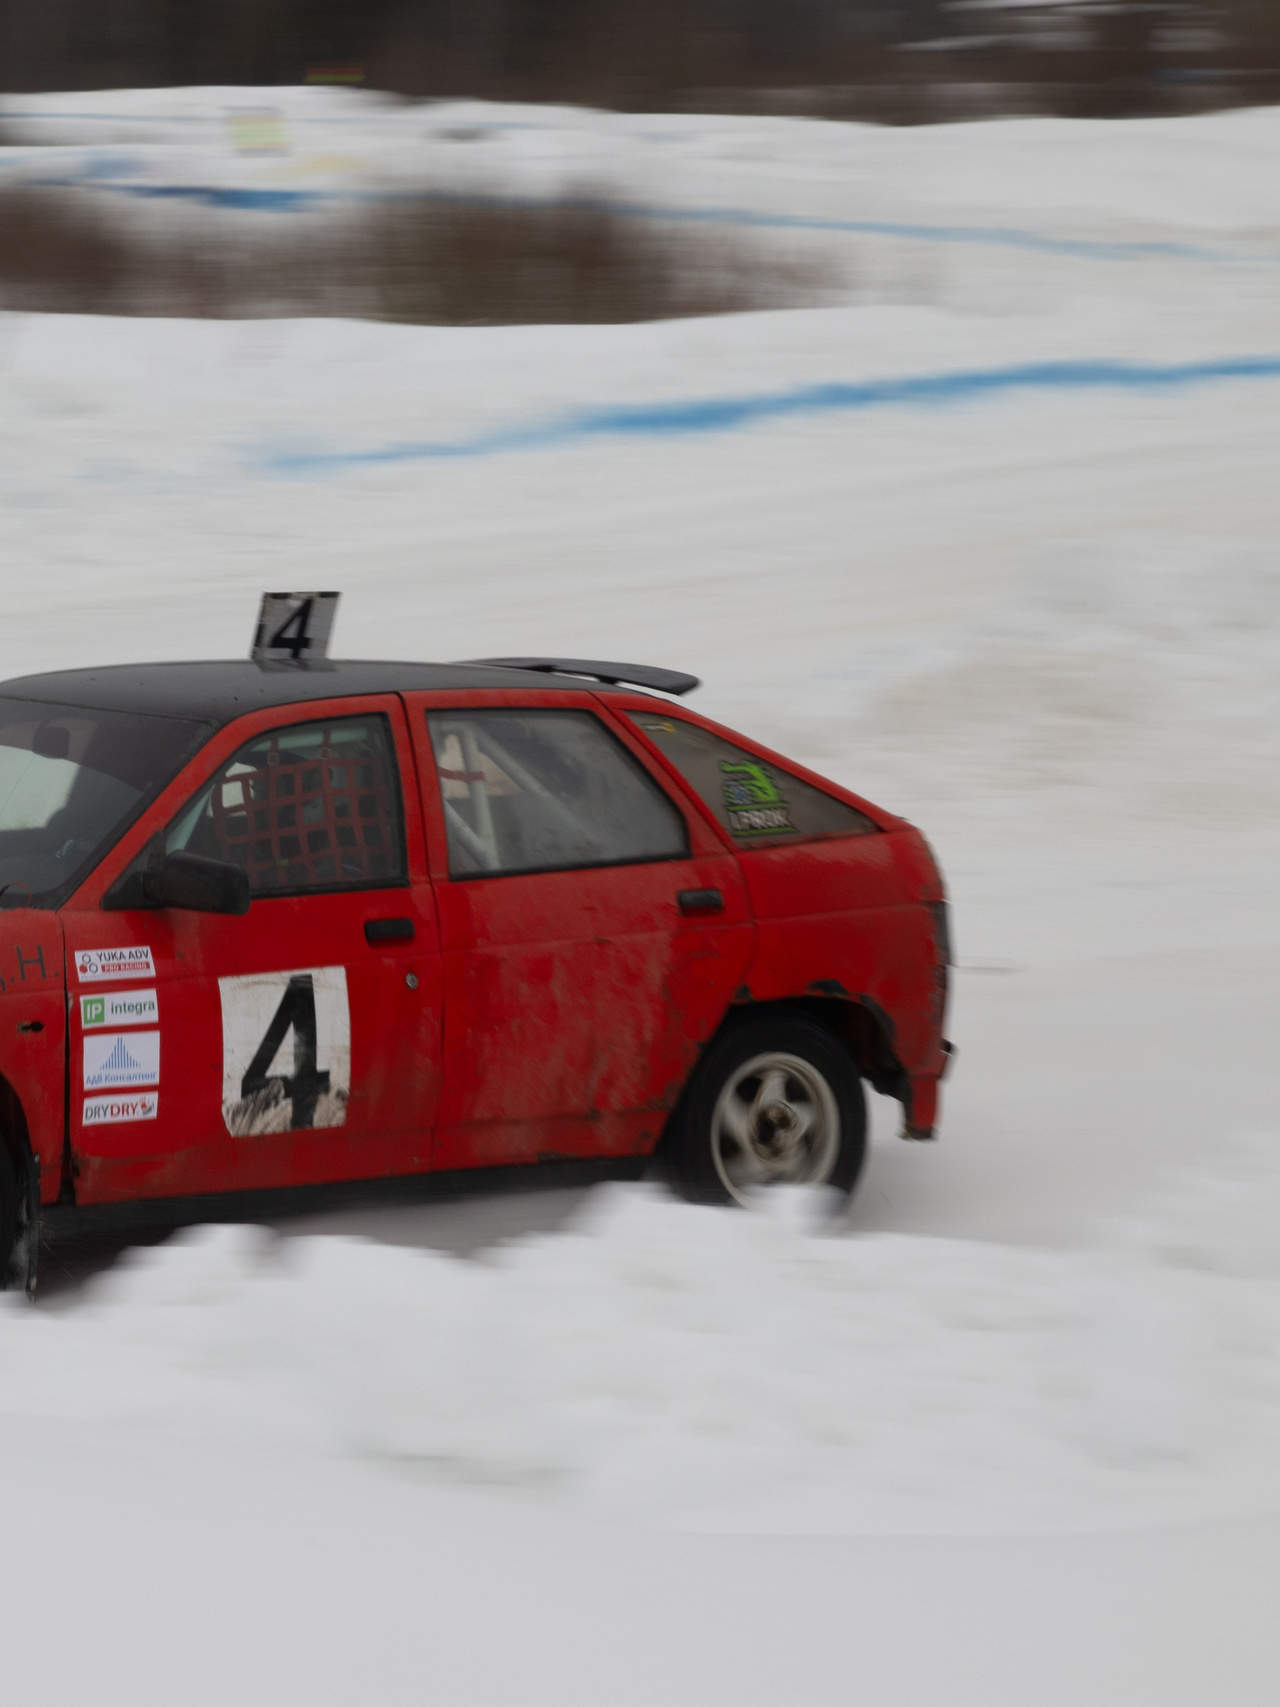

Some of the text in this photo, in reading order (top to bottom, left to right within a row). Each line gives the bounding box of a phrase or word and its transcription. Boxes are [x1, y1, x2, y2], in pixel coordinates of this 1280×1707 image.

[270, 597, 314, 659] 4
[96, 949, 149, 962] YUKA ADV
[104, 962, 147, 973] PRO RACING
[86, 1002, 103, 1020] IP
[110, 1000, 156, 1017] integra
[241, 974, 330, 1130] 4
[104, 1071, 157, 1084] Консалтинг
